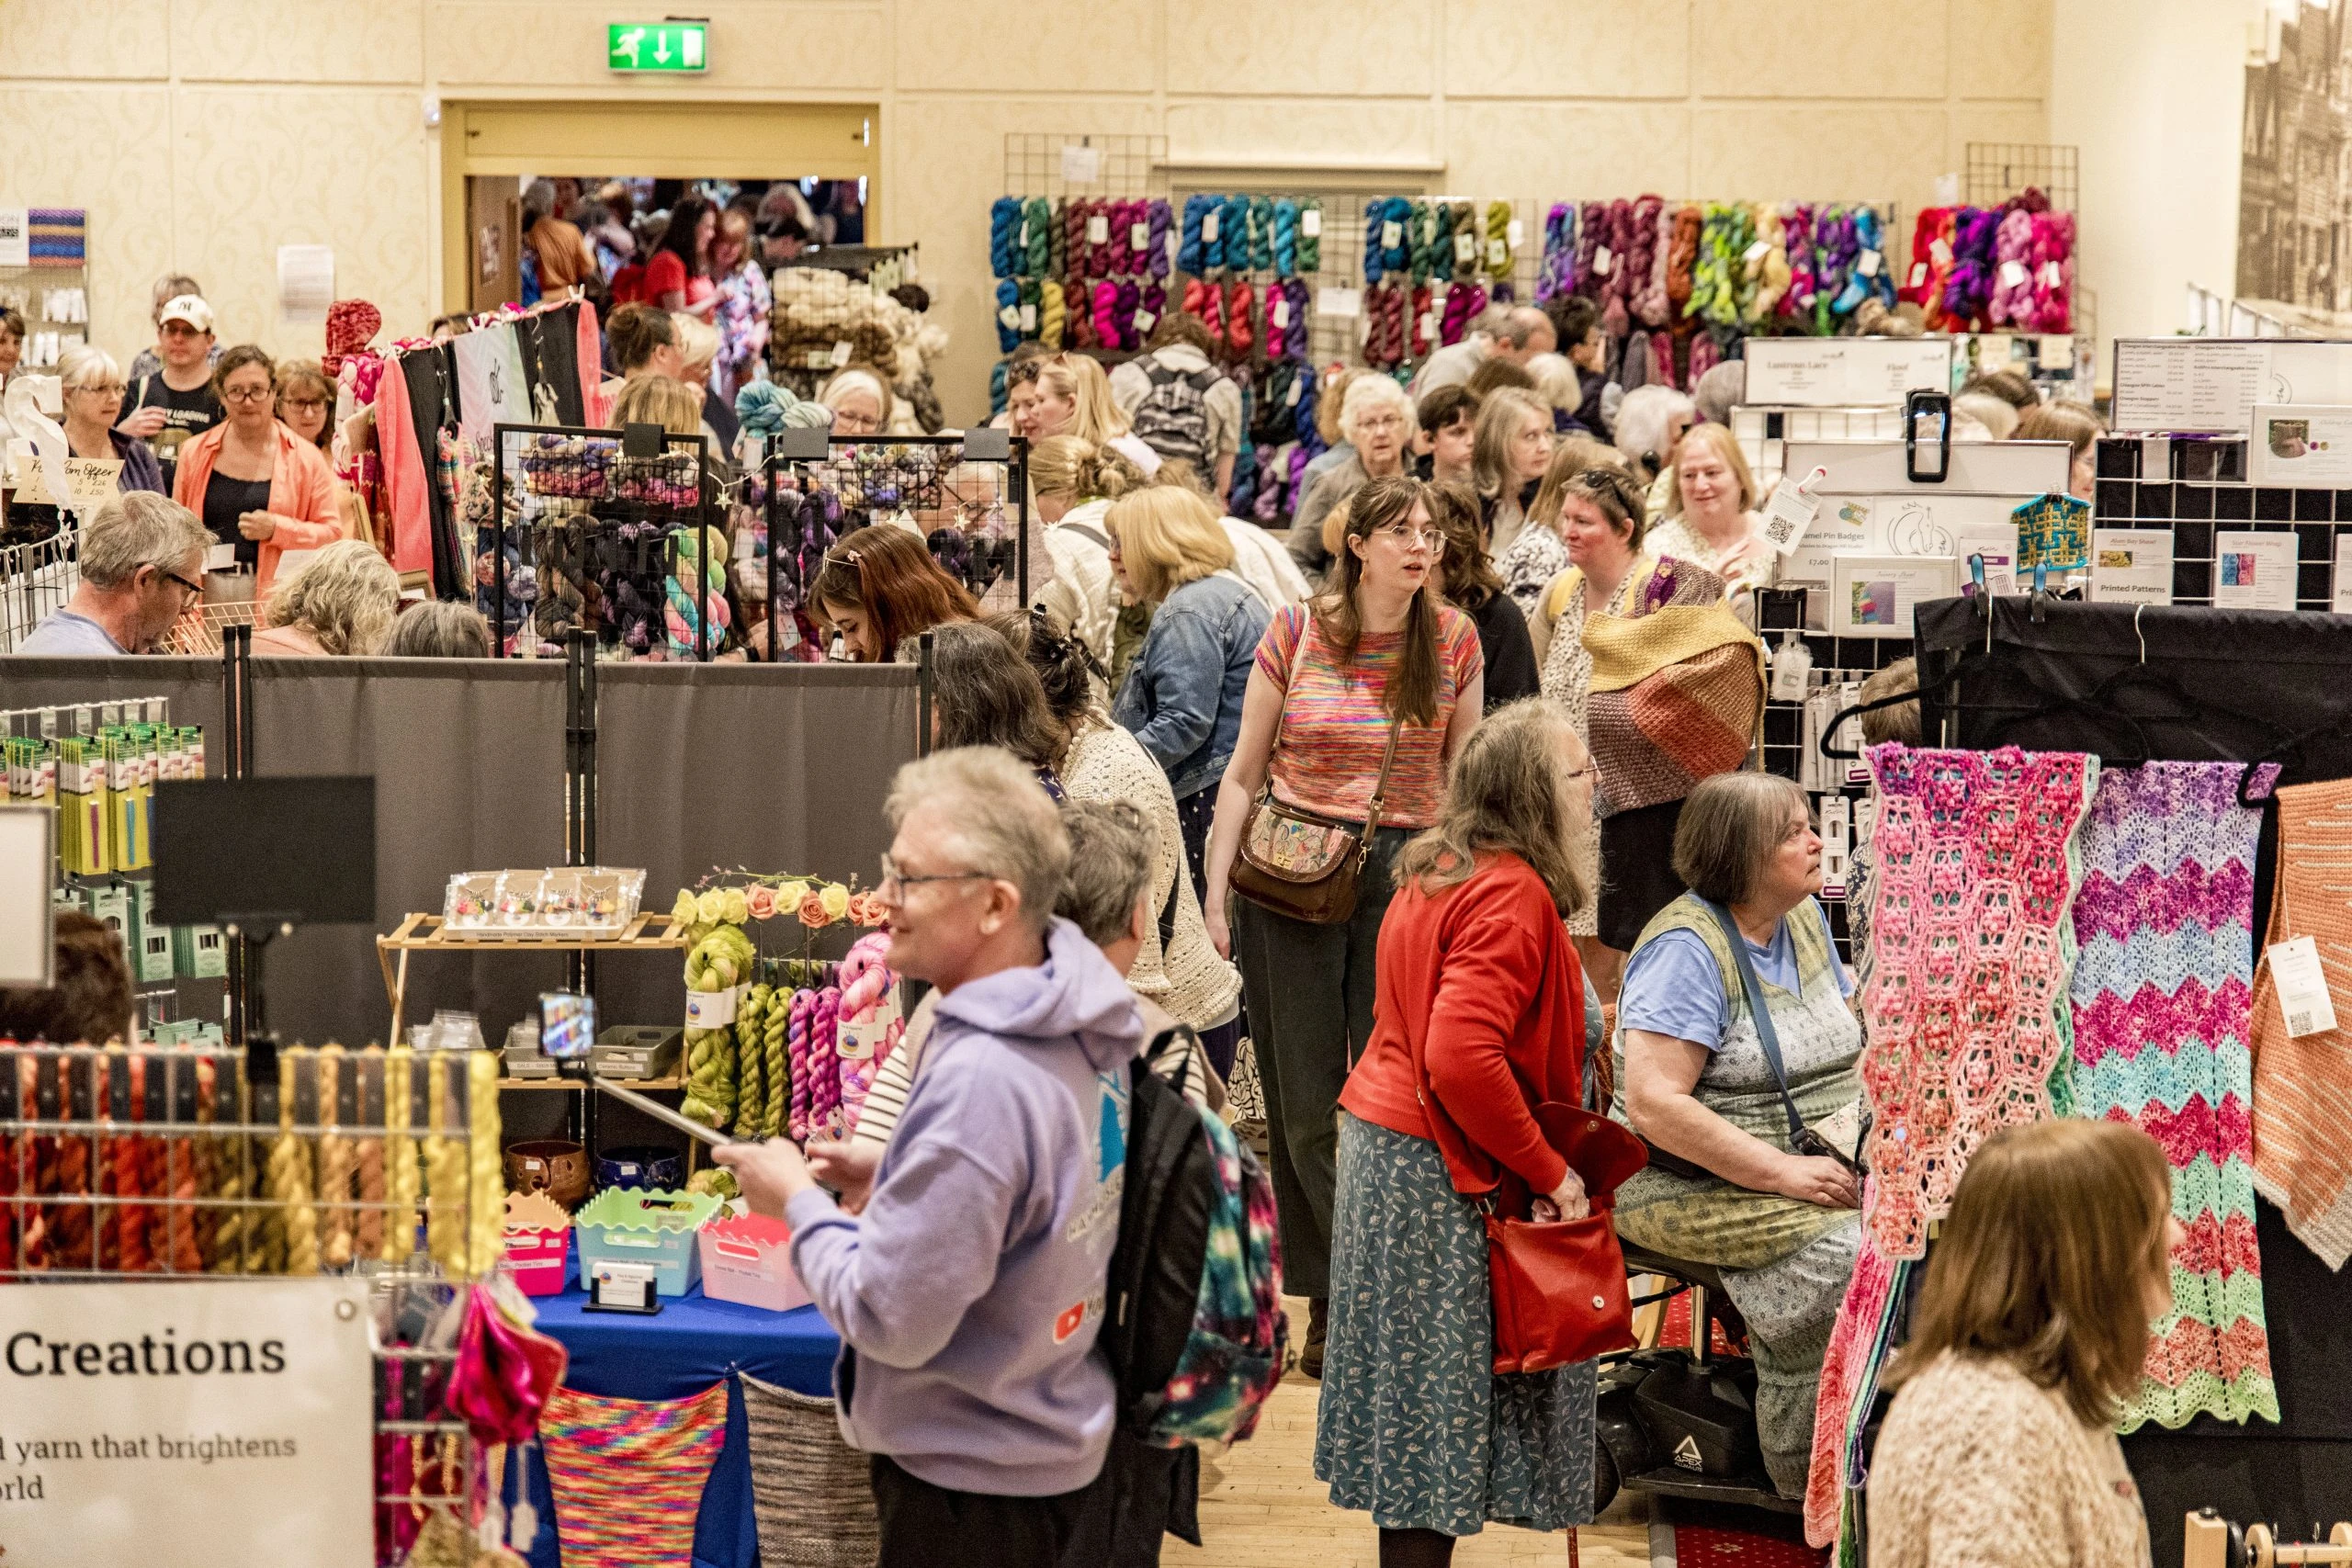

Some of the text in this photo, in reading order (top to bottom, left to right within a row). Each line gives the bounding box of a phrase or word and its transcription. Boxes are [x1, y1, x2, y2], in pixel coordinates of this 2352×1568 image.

[83, 463, 116, 480] Offer
[1838, 533, 1865, 542] Badges
[1808, 558, 1829, 567] £7.00
[2100, 584, 2165, 593] Printed Patterns
[6, 1328, 287, 1376] Creations
[15, 1438, 83, 1466] yarn
[92, 1433, 150, 1460] that
[158, 1433, 298, 1464] brightens
[1674, 1454, 1702, 1468] APEX
